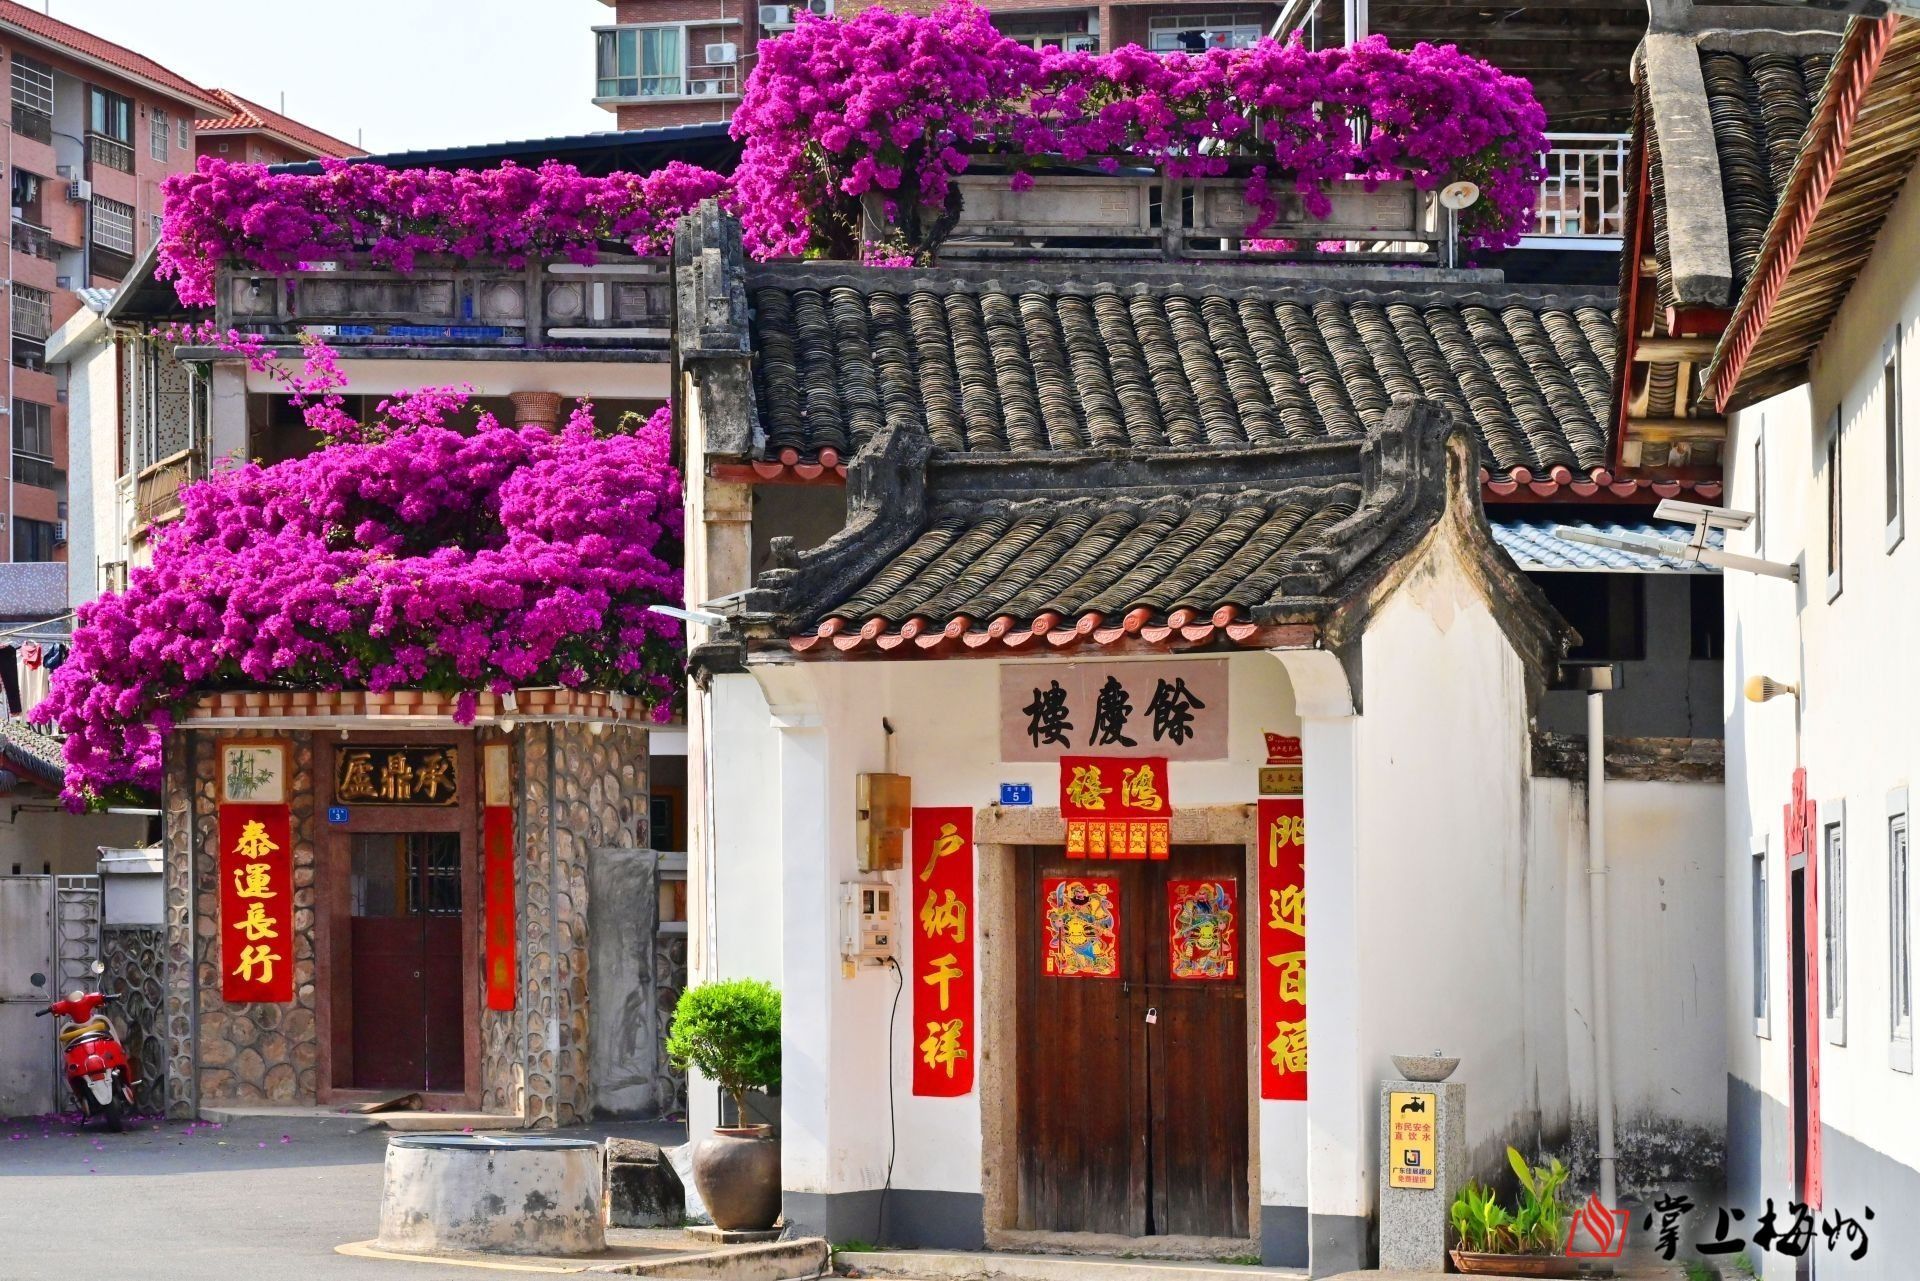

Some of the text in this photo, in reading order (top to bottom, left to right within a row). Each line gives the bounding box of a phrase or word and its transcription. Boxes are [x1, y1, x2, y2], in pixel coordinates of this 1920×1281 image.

[1012, 792, 1020, 801] 5
[232, 819, 281, 984] 泰運長行
[1395, 1122, 1431, 1131] 市民安全
